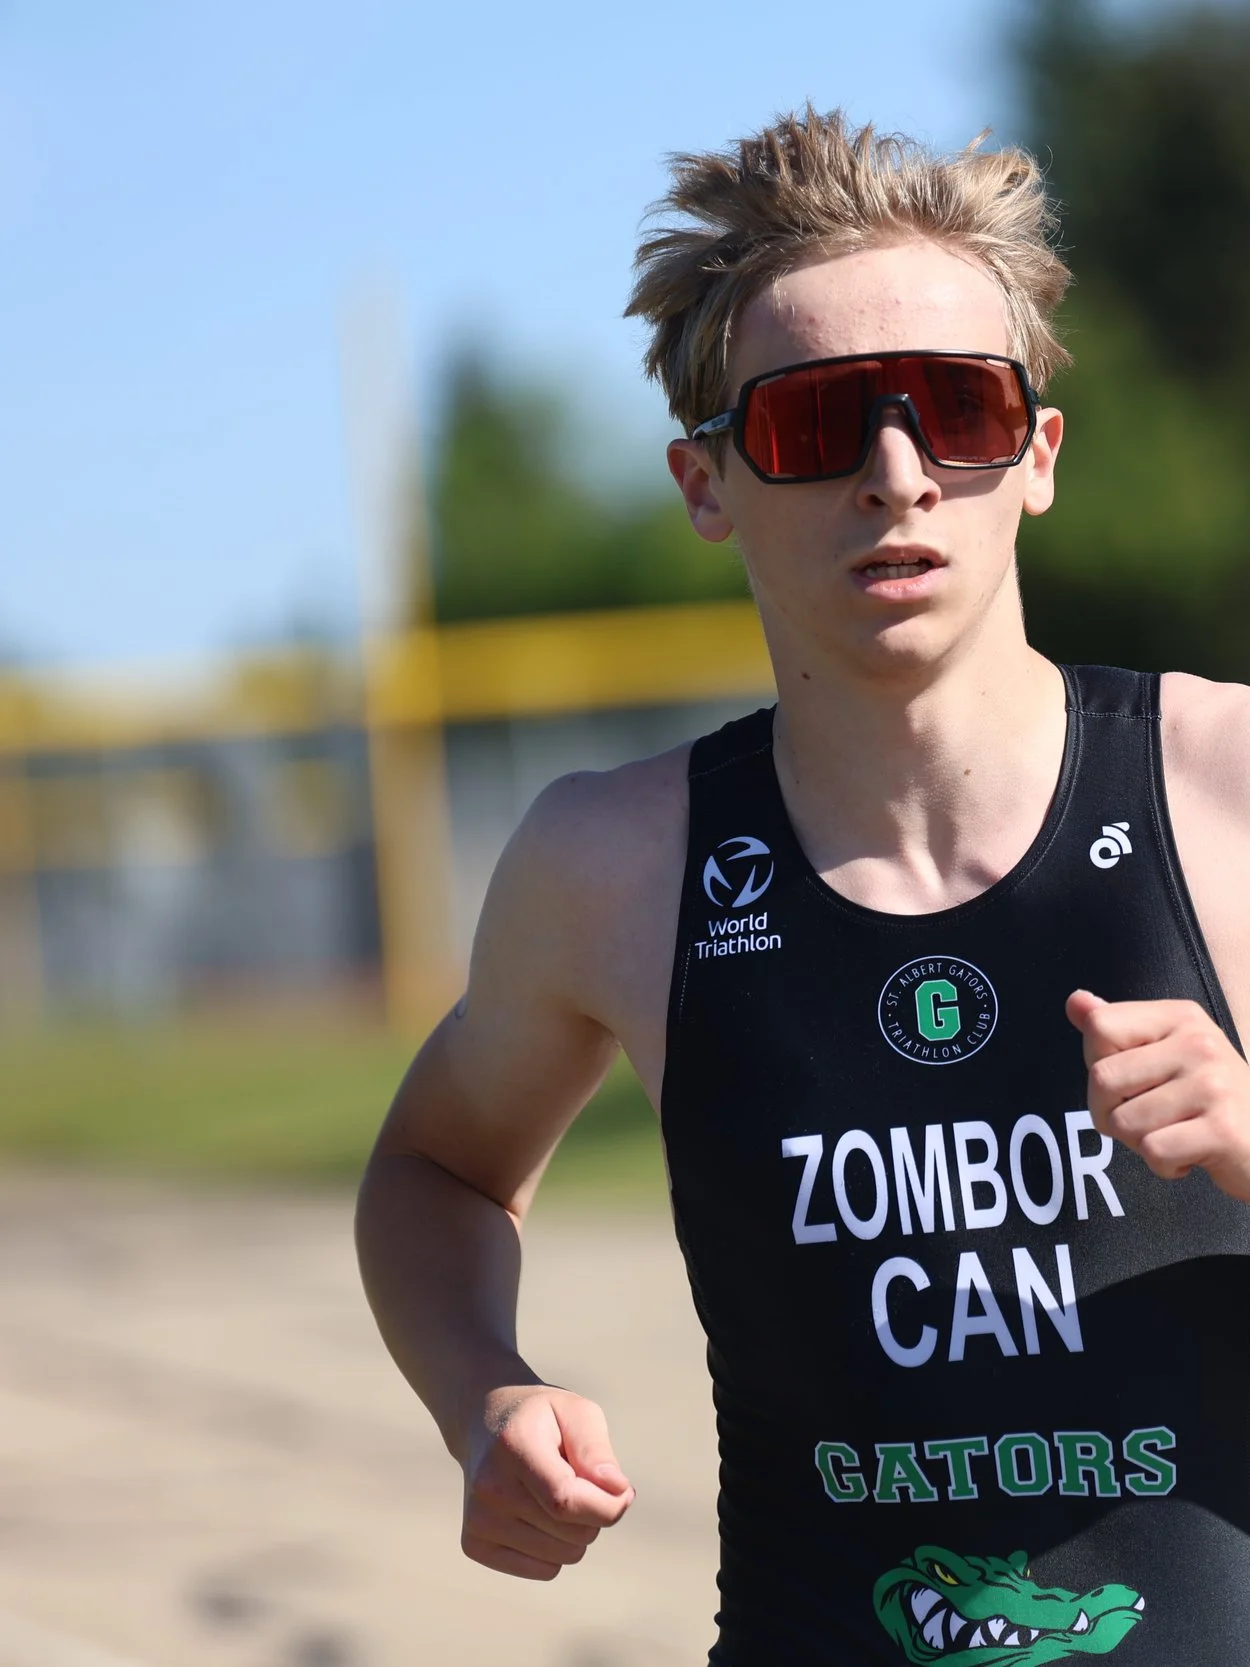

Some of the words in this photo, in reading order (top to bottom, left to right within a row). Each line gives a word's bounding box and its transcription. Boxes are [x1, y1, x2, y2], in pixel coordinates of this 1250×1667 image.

[695, 934, 782, 960] Triathlon
[708, 912, 767, 937] World
[886, 991, 902, 1007] ST.
[899, 962, 942, 987] ALBERT
[948, 964, 988, 1000] GATORS
[914, 979, 961, 1041] G
[888, 1021, 962, 1058] TRIATHLON
[967, 1013, 990, 1045] CLUB
[781, 1110, 1126, 1245] ZOMBOR
[871, 1244, 1085, 1368] CAN
[814, 1425, 1177, 1504] GATORS
